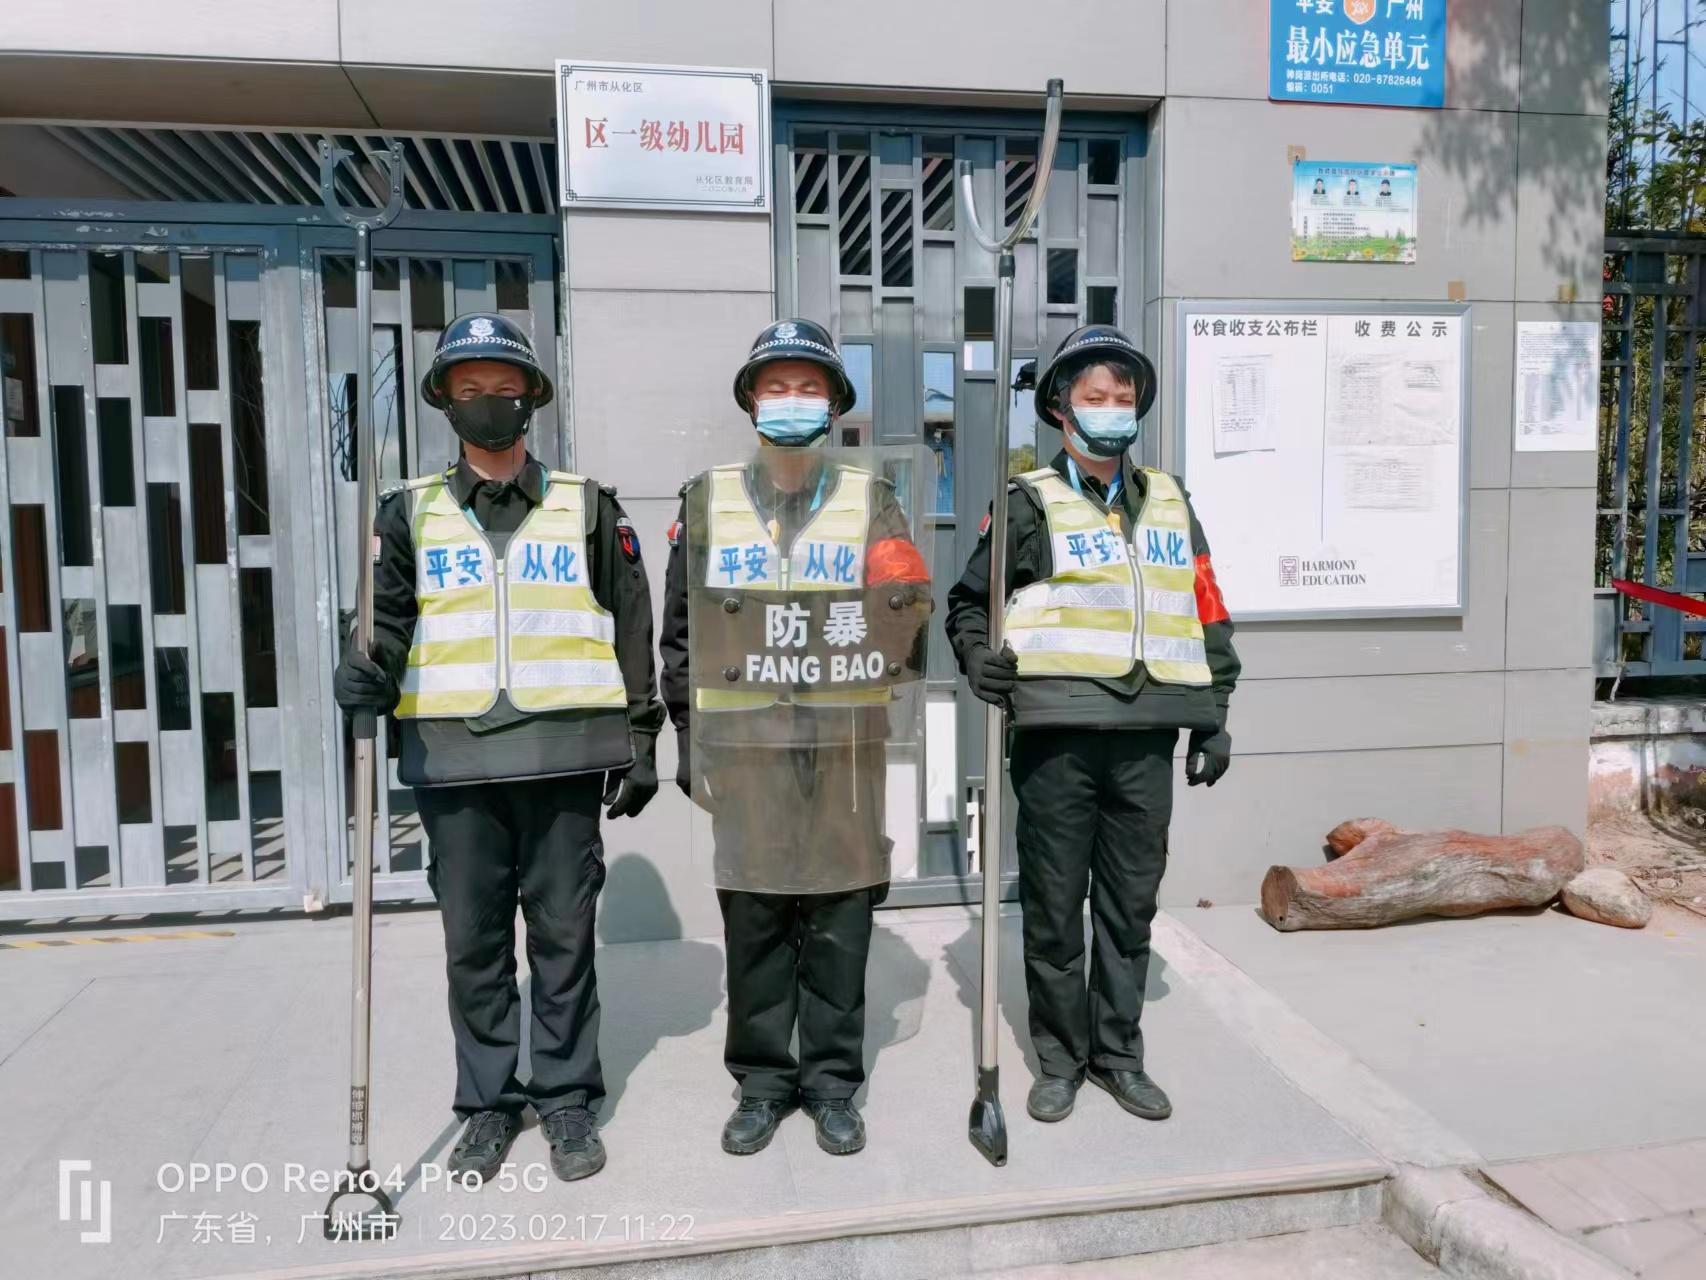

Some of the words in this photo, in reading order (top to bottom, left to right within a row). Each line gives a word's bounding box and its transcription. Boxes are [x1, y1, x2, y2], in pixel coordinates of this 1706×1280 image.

[1286, 25, 1430, 70] 最小应急单元
[574, 80, 643, 93] 广州市从化区
[585, 117, 744, 155] 区一级幼儿园
[695, 175, 753, 186] 从化区教育局
[1193, 319, 1318, 337] 伙食收支公布栏
[1354, 320, 1448, 338] 收费公示
[719, 543, 768, 584] 平安
[804, 543, 856, 582] 从化
[1065, 529, 1121, 567] 平安
[1146, 529, 1187, 566] 从化
[426, 545, 483, 588] 平安
[521, 543, 578, 582] 从化
[1302, 560, 1357, 572] HARMONY
[1302, 574, 1366, 586] EDUCATION
[765, 601, 867, 648] 防暴
[746, 654, 821, 683] FANG
[830, 651, 884, 683] BAO
